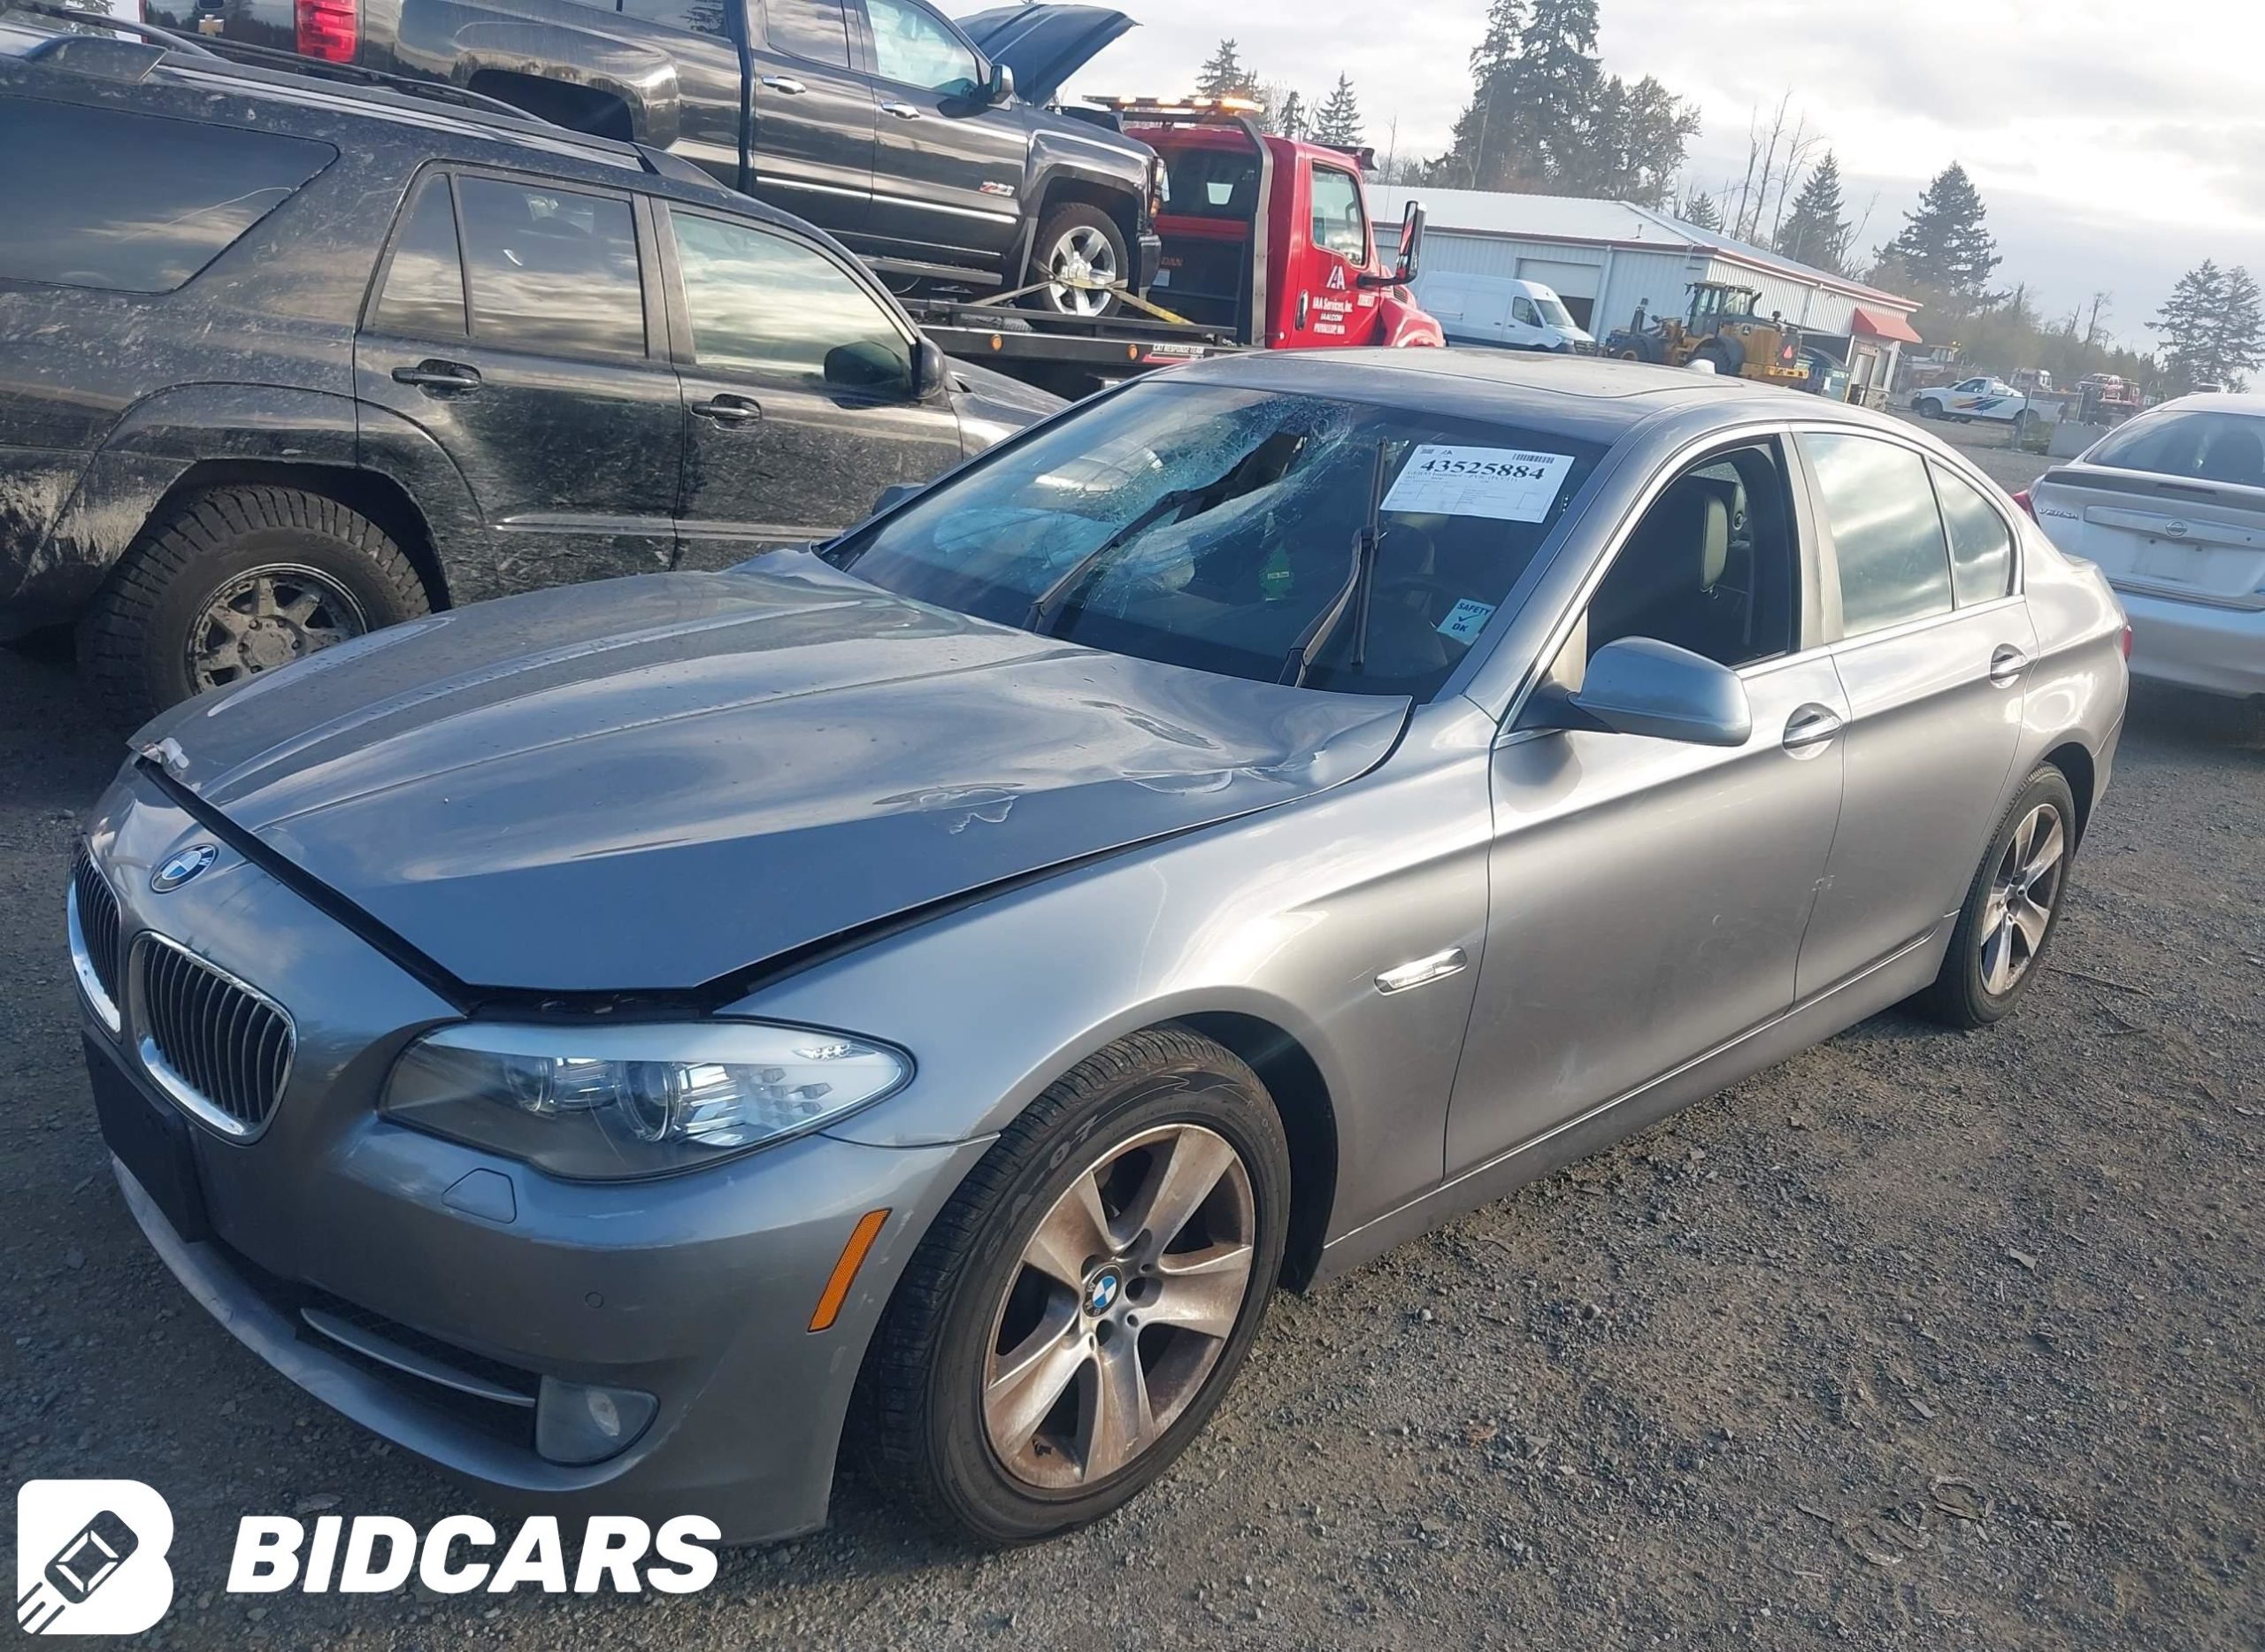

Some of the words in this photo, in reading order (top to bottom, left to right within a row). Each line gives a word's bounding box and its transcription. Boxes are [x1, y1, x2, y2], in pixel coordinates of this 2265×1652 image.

[1420, 459, 1546, 480] 43525884
[1457, 602, 1493, 616] SAFETY
[1452, 622, 1470, 633] OK
